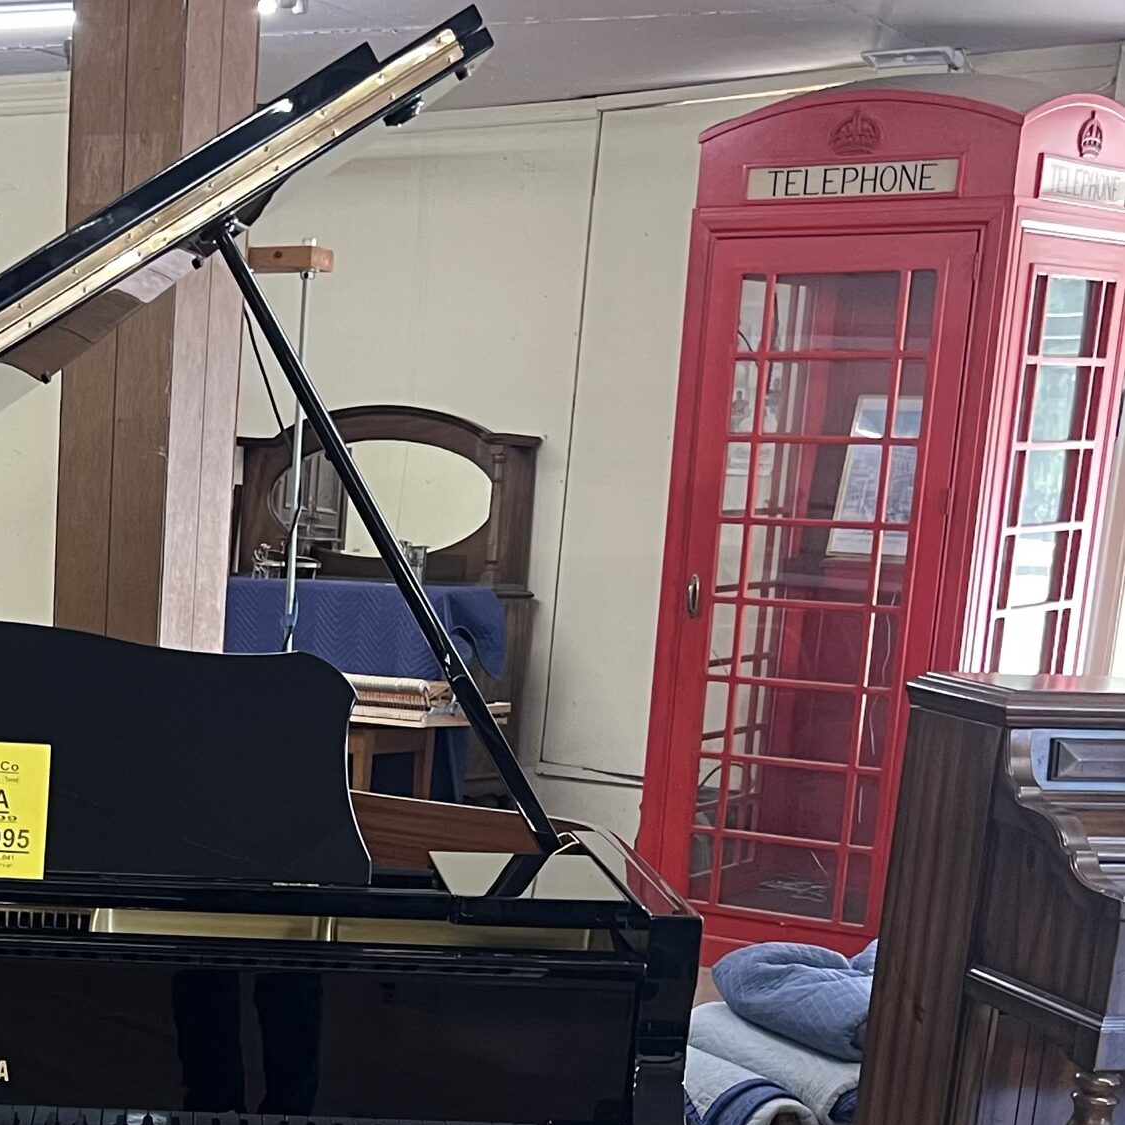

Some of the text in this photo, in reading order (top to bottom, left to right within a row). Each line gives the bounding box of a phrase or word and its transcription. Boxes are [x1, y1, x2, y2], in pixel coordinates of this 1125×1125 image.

[768, 163, 939, 197] TELEPHONE
[1050, 163, 1121, 203] TELEPHONE
[0, 761, 19, 771] Co
